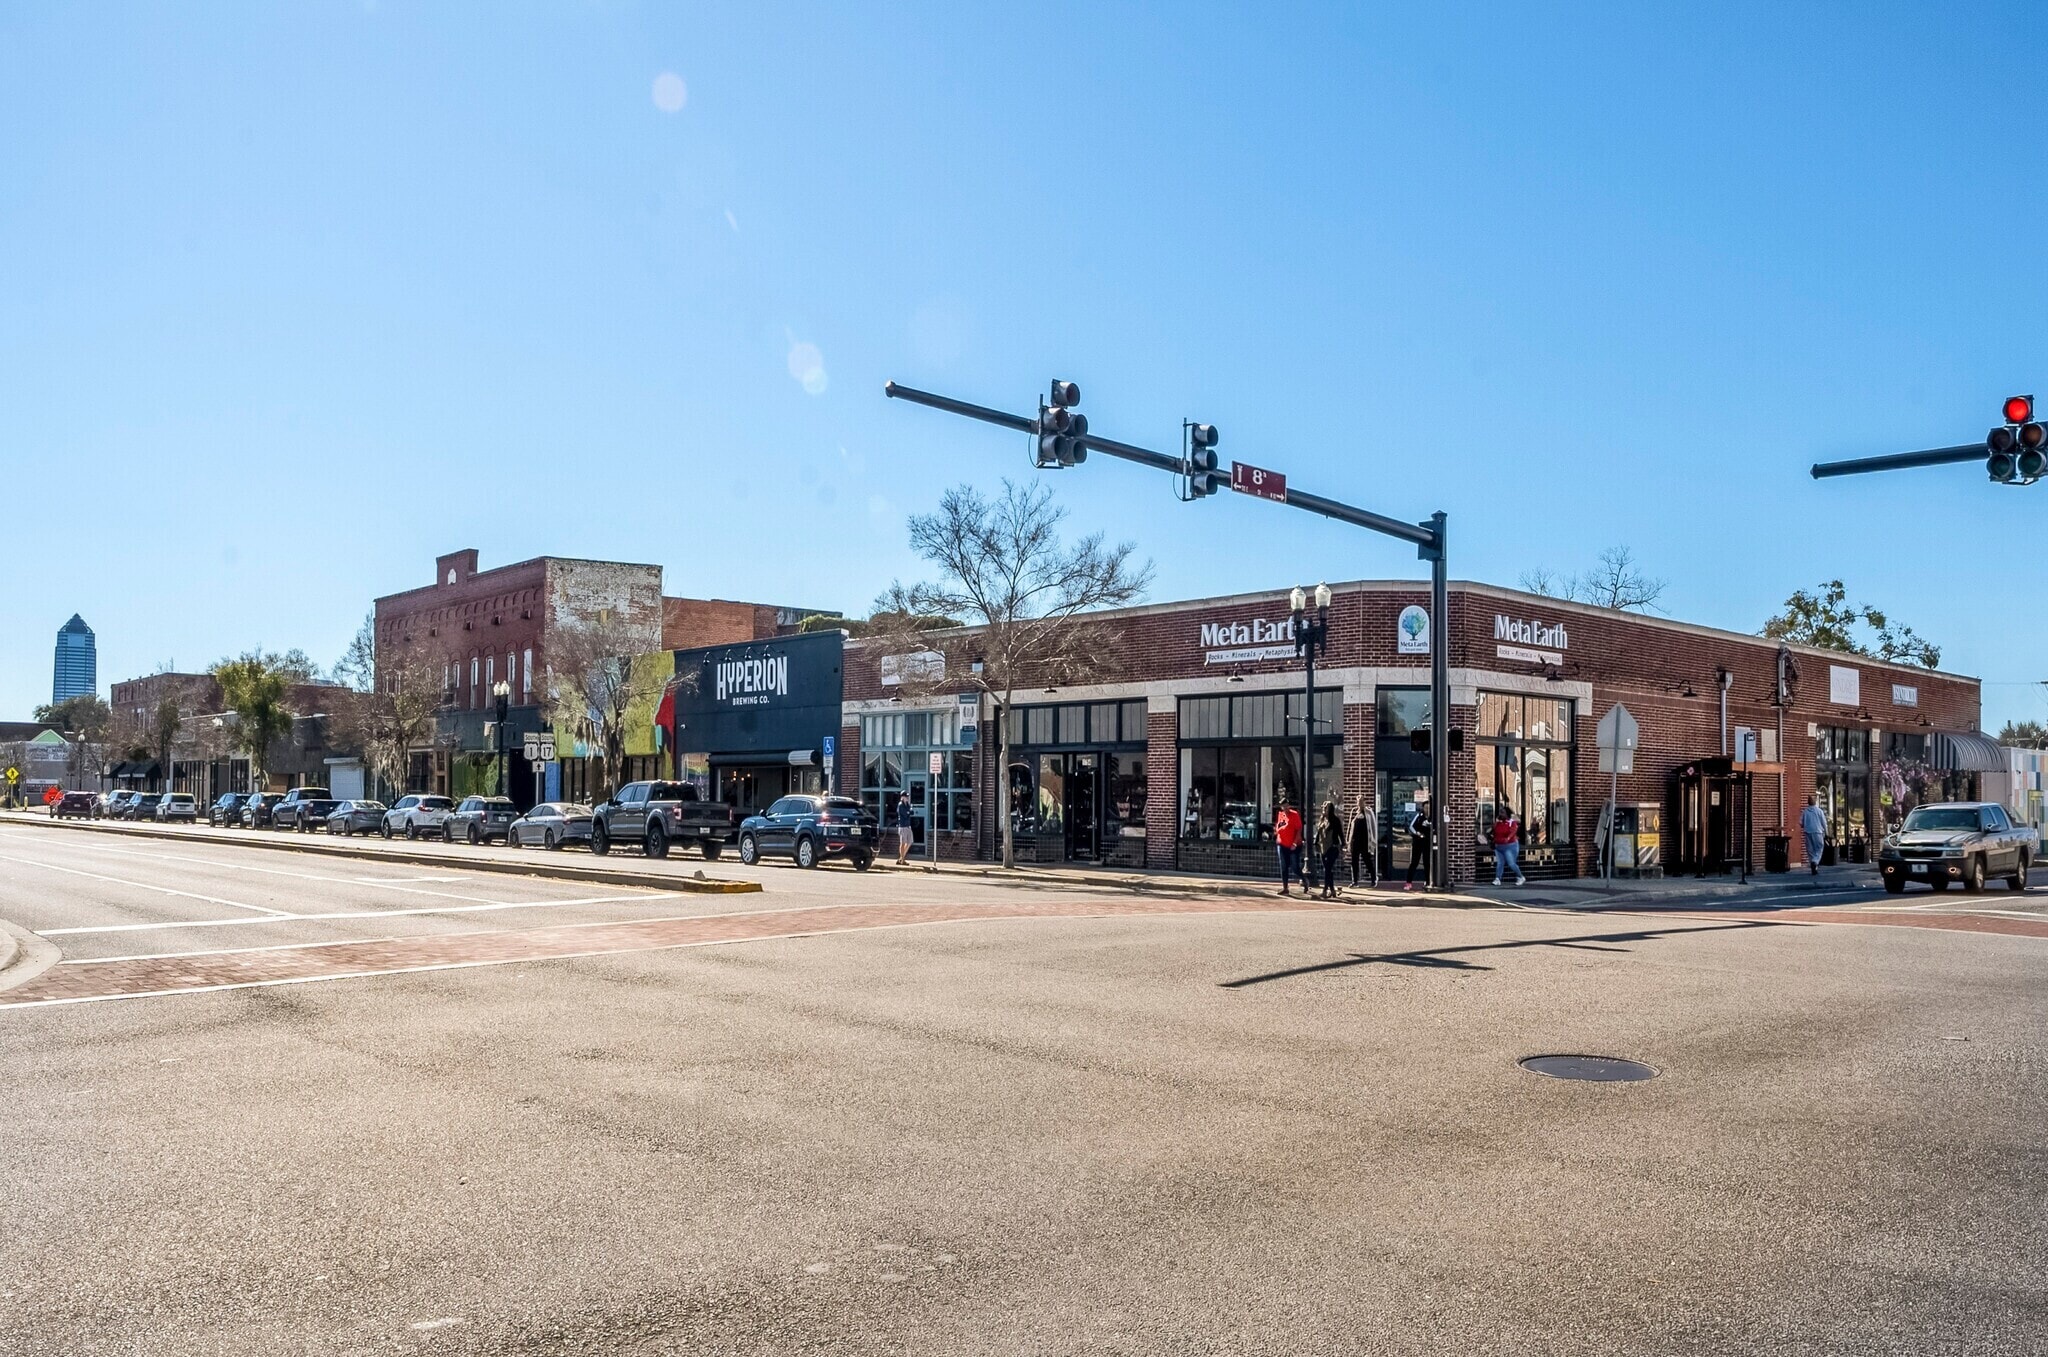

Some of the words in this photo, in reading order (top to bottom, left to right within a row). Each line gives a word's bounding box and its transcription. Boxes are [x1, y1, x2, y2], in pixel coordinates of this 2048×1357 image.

[1200, 621, 1250, 648] Meta
[1253, 615, 1309, 643] Eart
[1493, 614, 1531, 645] Meta
[1531, 620, 1568, 650] Earth
[717, 656, 787, 700] HYPERION
[732, 696, 758, 706] BREWING
[759, 695, 770, 704] CO.
[529, 747, 533, 757] 1
[543, 747, 552, 757] 17
